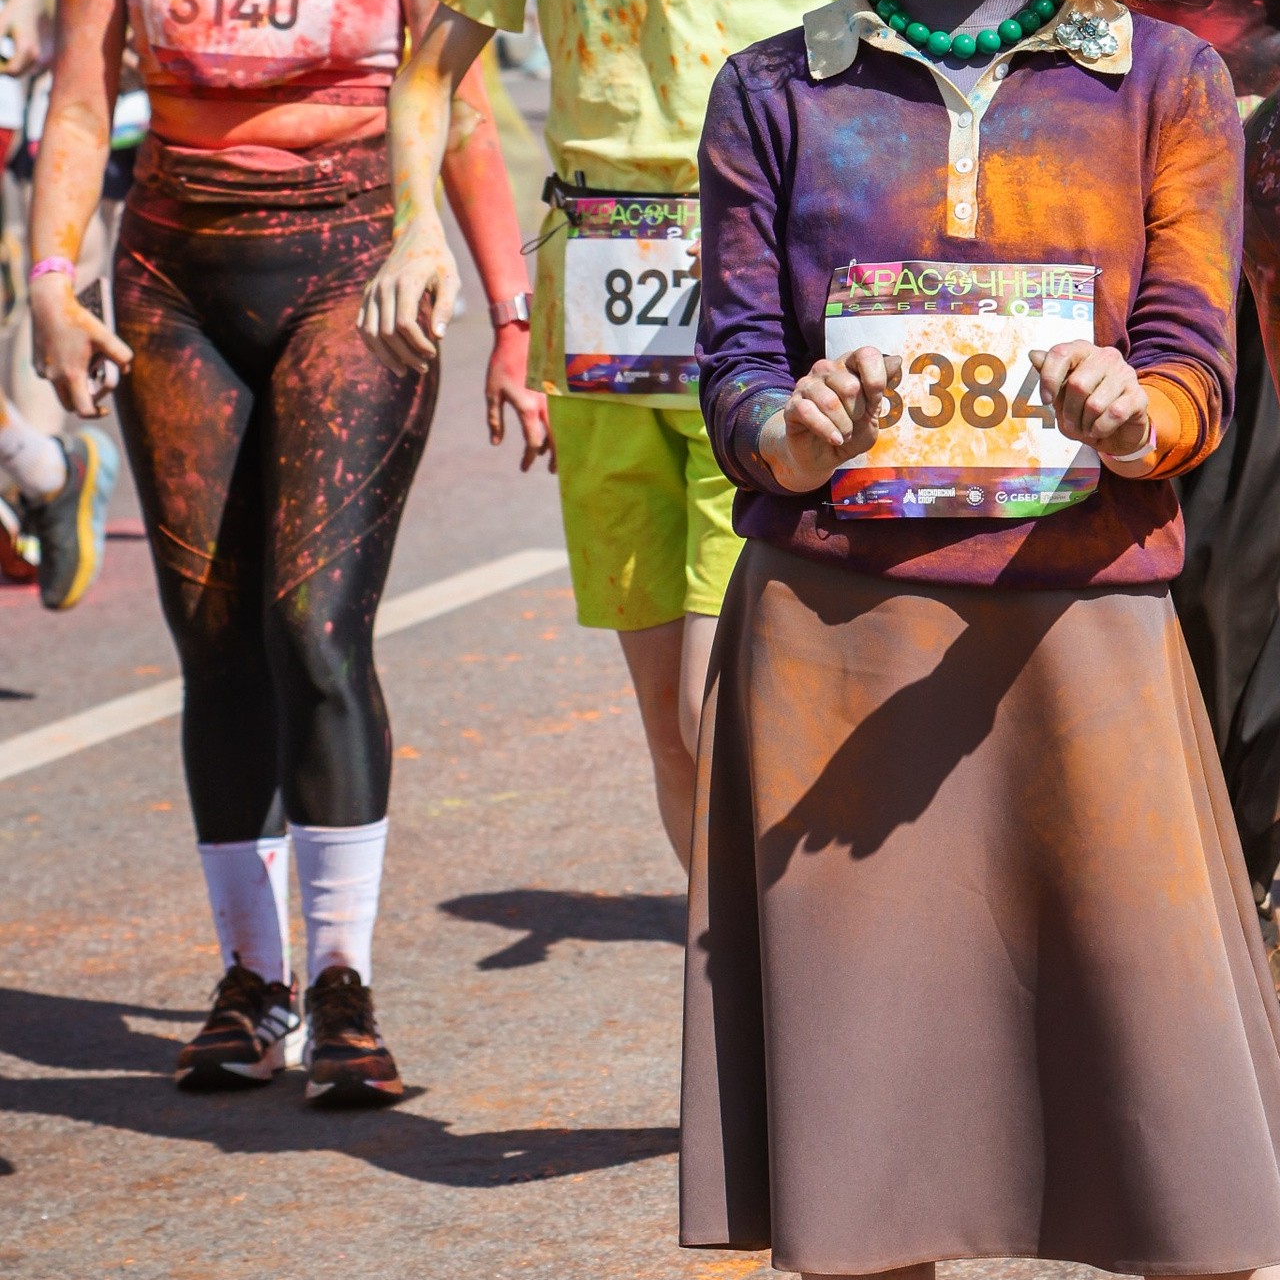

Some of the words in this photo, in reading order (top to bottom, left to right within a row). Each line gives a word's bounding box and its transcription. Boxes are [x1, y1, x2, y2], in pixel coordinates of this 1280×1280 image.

[581, 203, 700, 225] КРАСОЧН
[850, 268, 1073, 299] КРАСОЧНЫЙ
[848, 301, 964, 312] ЗАБЕГ
[978, 299, 1089, 320] 2026
[918, 487, 956, 497] МОСКОВСКИЙ
[1010, 493, 1039, 502] СБЕР
